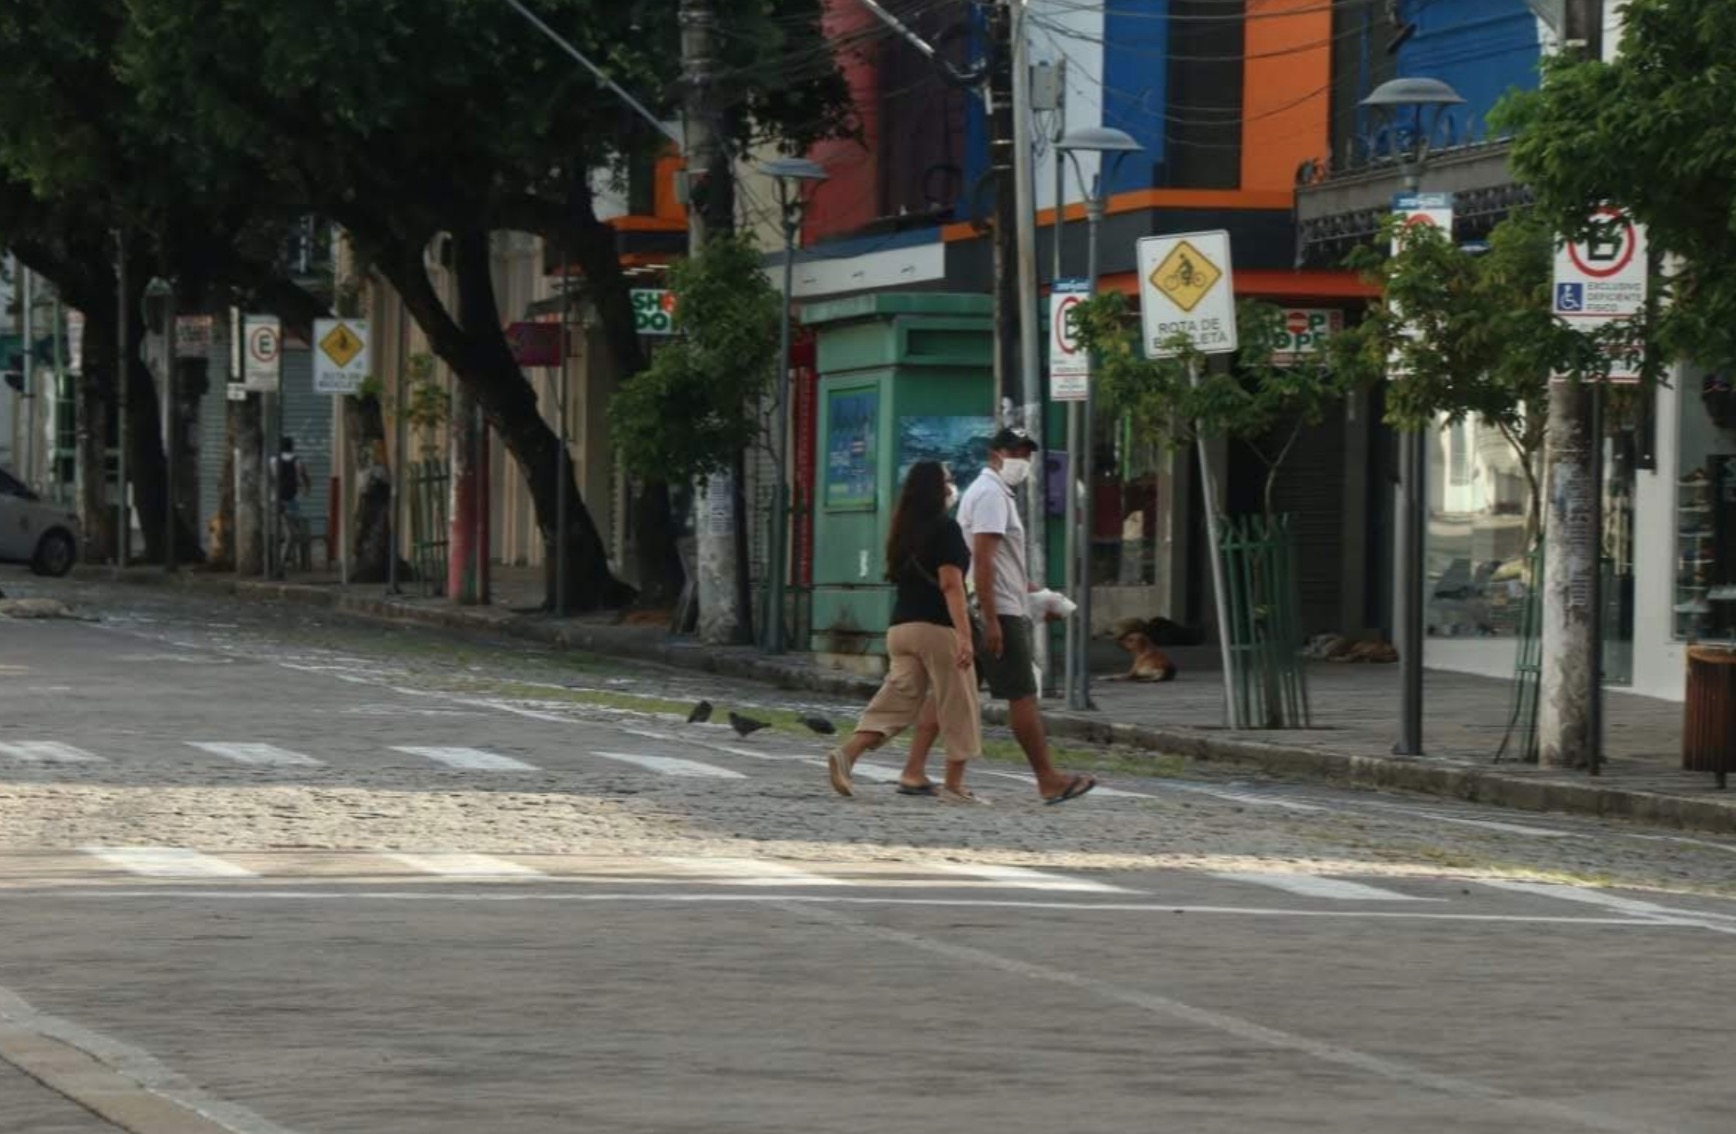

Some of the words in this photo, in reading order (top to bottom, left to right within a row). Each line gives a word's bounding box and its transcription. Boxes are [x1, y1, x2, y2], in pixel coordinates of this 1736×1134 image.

[1586, 292, 1642, 302] DEFICIENTE
[1158, 320, 1197, 334] ROTA
[1201, 317, 1220, 331] DE
[259, 334, 271, 354] E
